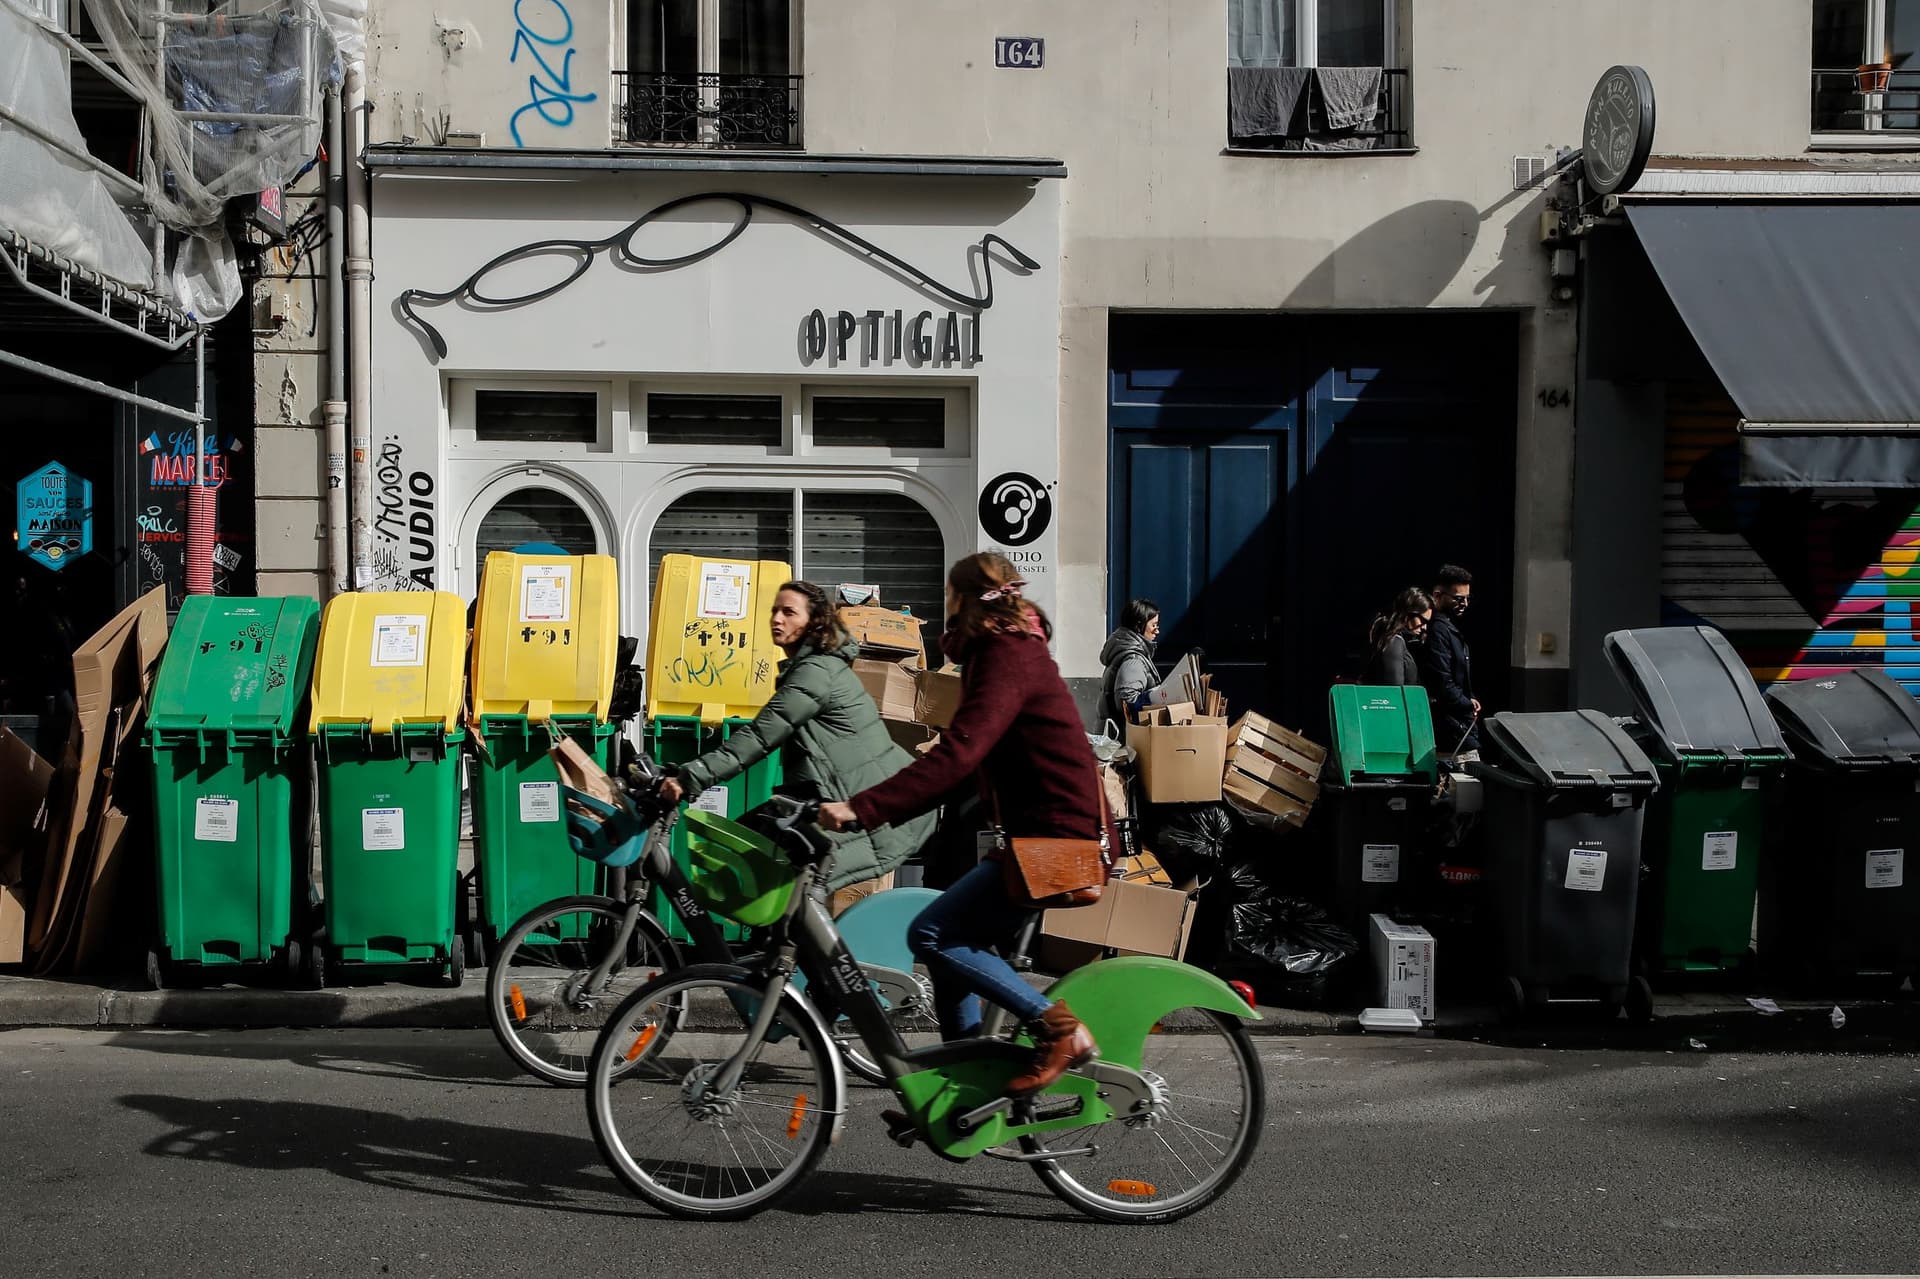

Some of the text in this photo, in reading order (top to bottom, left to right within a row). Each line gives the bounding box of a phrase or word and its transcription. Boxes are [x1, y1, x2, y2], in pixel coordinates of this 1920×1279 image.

[998, 41, 1040, 65] 164
[1538, 388, 1571, 408] 164
[169, 428, 219, 459] Kig
[26, 497, 84, 509] SAUCES
[28, 519, 82, 531] MAISON
[409, 471, 435, 591] AUDIO
